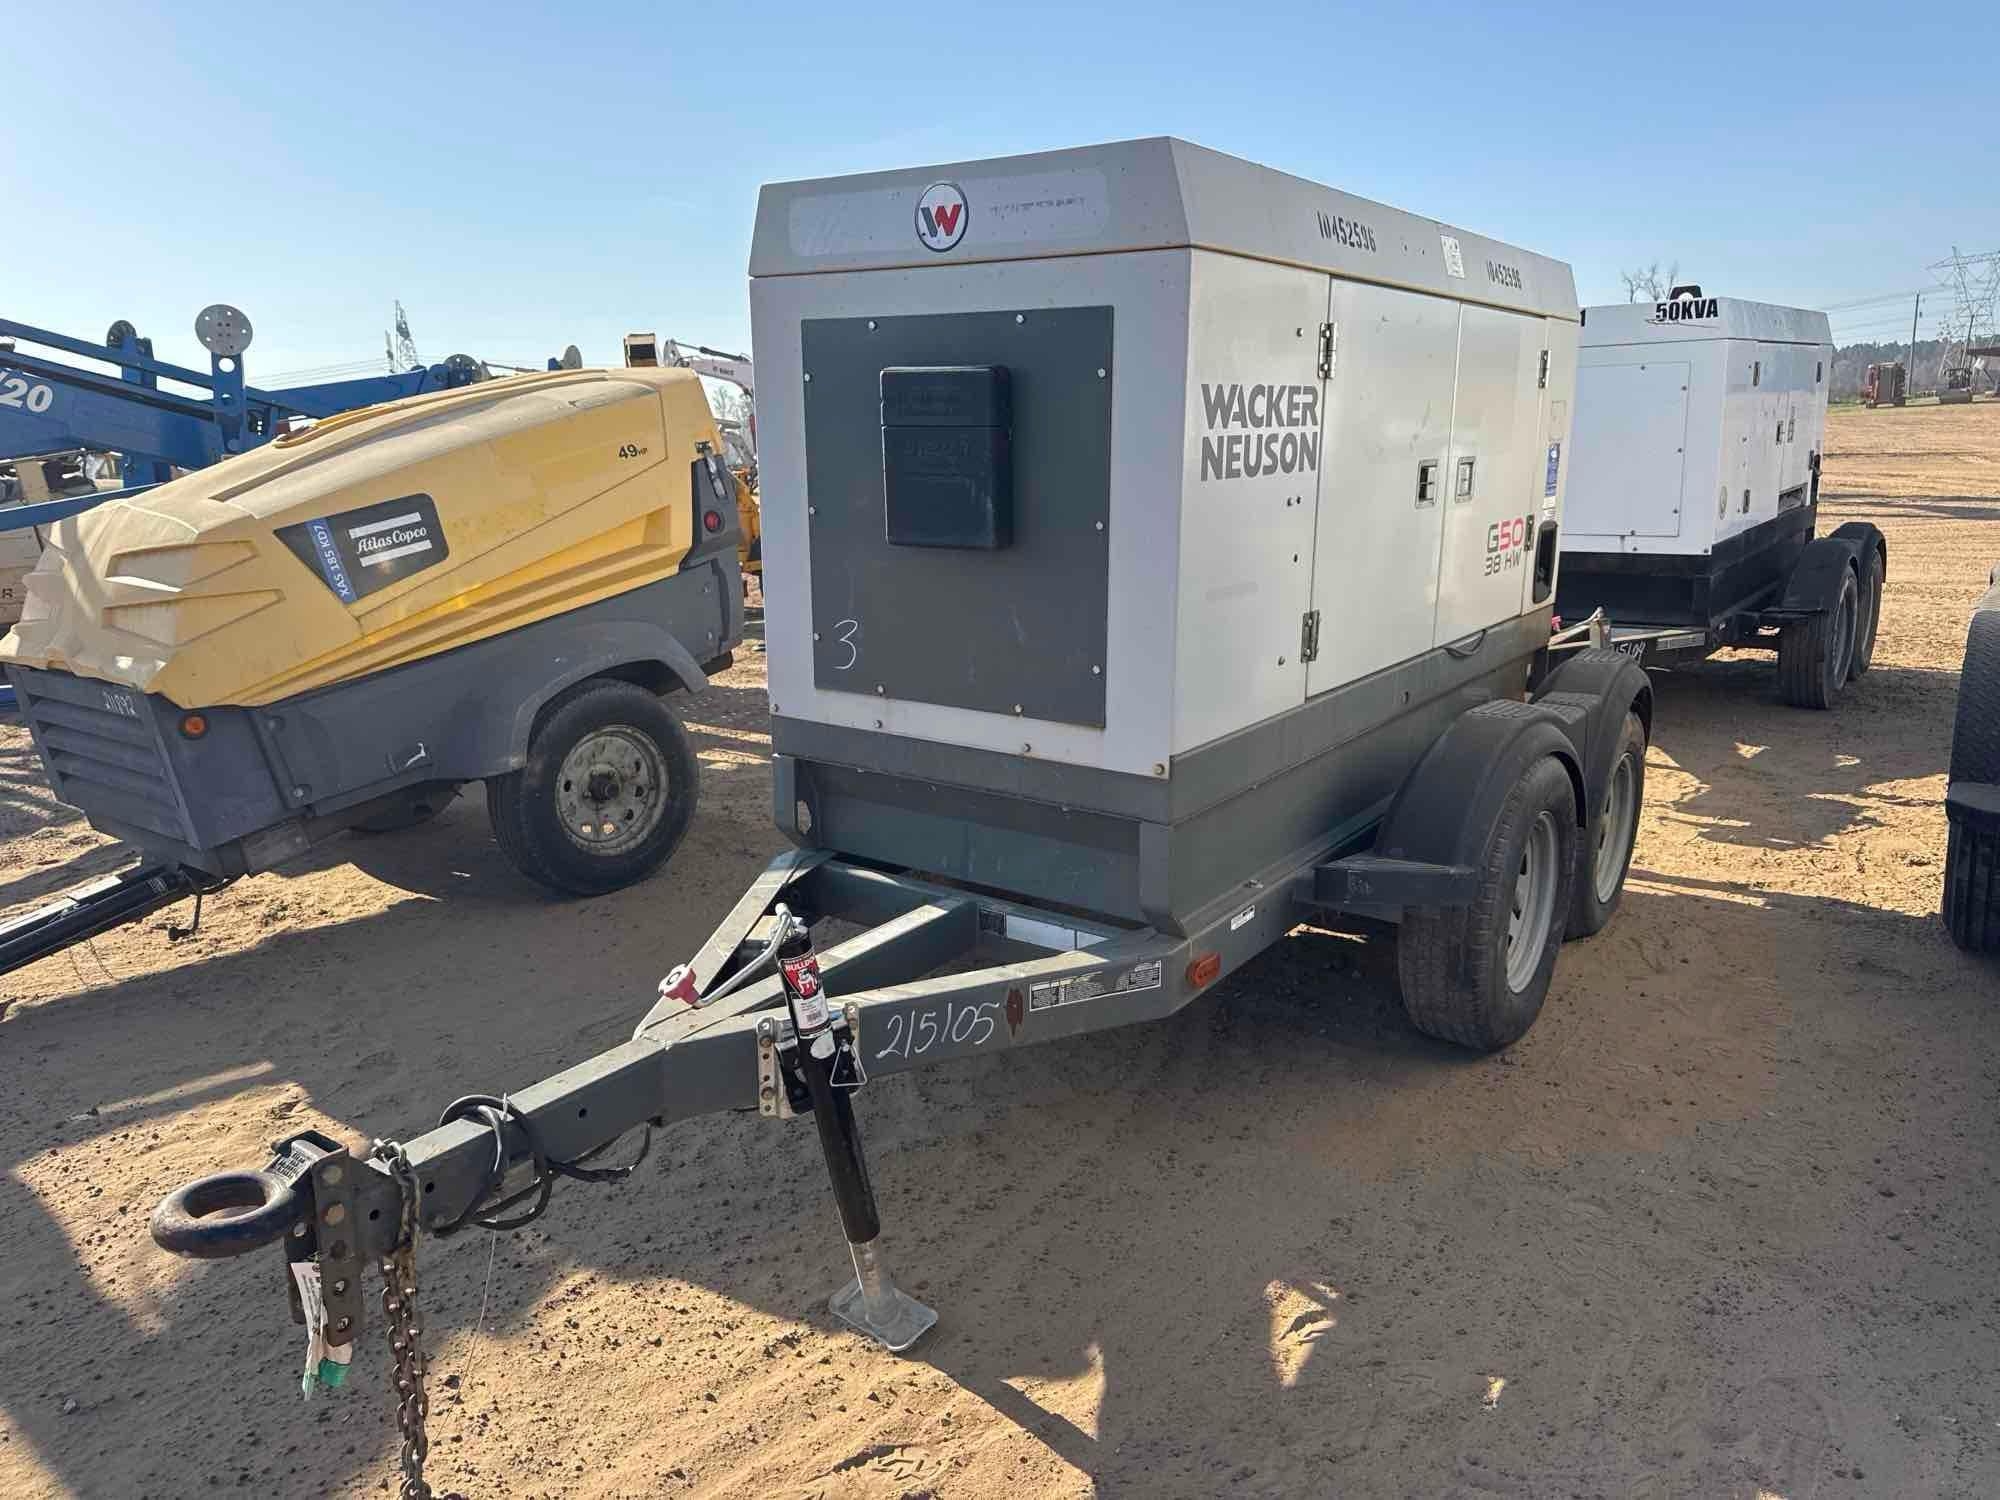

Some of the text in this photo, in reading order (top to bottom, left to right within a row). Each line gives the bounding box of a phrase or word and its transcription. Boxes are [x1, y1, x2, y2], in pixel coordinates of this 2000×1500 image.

[1656, 299, 1719, 322] 50KVA
[0, 371, 53, 413] 20
[1200, 383, 1319, 429] WACKER
[1200, 431, 1318, 481] NEUSON
[356, 526, 428, 555] Atlas Copco
[1487, 517, 1525, 553] G50
[324, 550, 340, 571] 185
[1484, 554, 1502, 576] 38
[333, 573, 351, 597] XAS
[833, 619, 858, 670] 3
